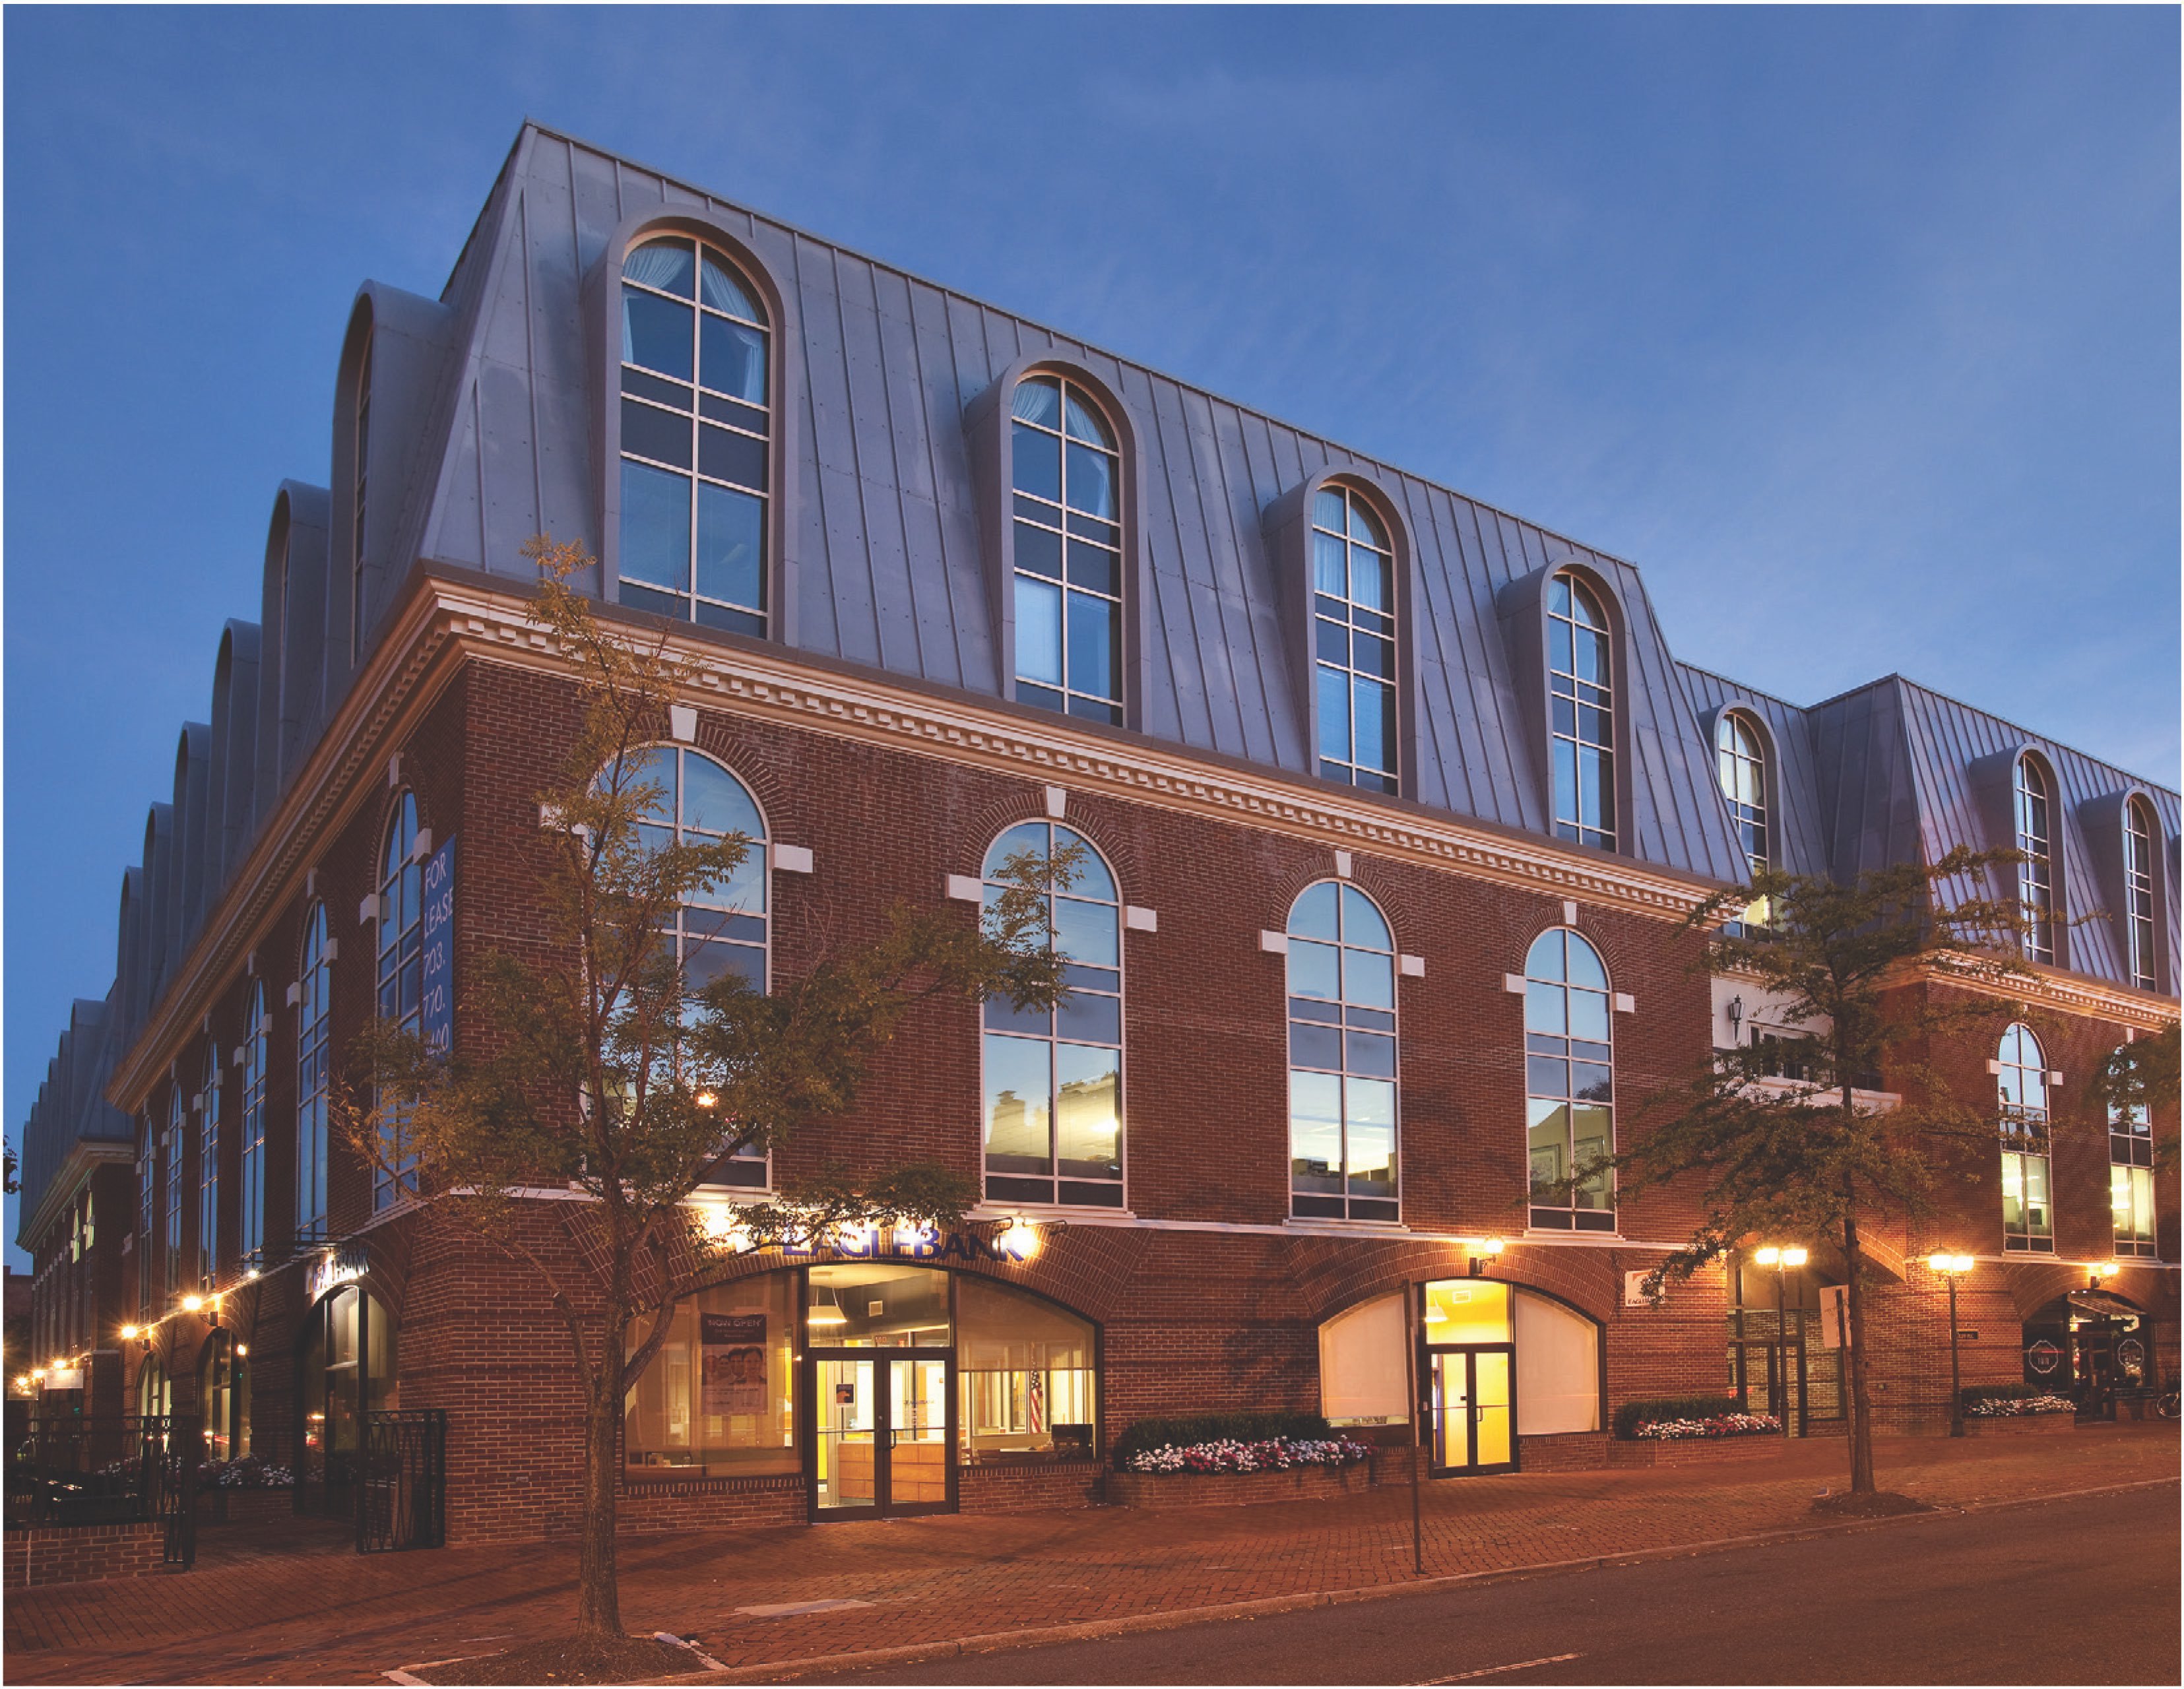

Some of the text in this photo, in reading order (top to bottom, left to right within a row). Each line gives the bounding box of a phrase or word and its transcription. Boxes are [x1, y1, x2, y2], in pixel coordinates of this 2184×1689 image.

[425, 851, 447, 897] FOR
[424, 885, 453, 940] LEASE
[423, 941, 445, 980] 703.
[423, 984, 445, 1019] 770.
